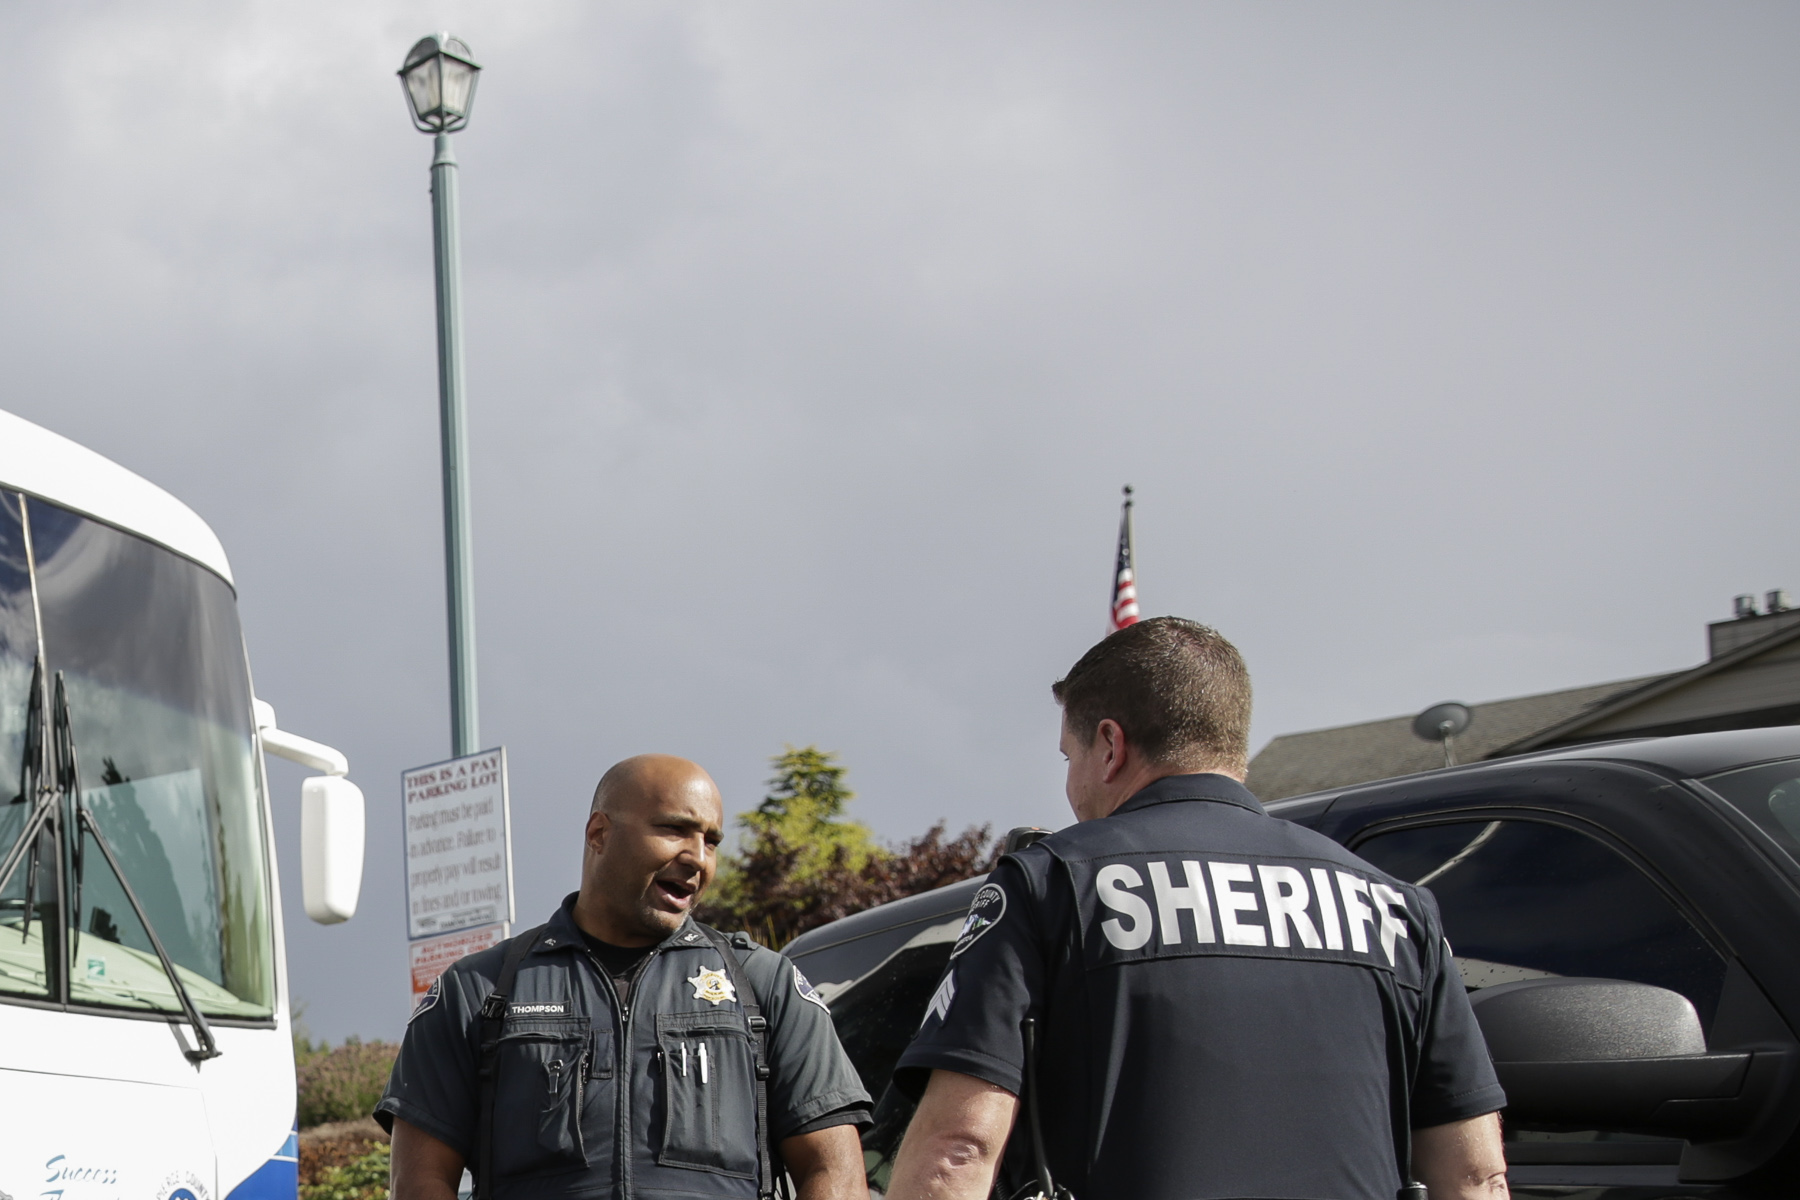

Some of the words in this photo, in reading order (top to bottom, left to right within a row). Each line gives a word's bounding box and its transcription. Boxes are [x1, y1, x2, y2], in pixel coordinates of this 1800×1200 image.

[406, 771, 437, 789] THIS
[440, 767, 453, 781] IS
[456, 764, 467, 778] A
[470, 755, 499, 773] PAY
[407, 779, 468, 804] PARKING
[471, 771, 498, 789] LOT
[408, 809, 439, 832] Parking
[461, 801, 473, 819] be
[1096, 860, 1408, 968] SHERIFF
[511, 1004, 564, 1014] THOMPSON
[45, 1154, 117, 1185] Success
